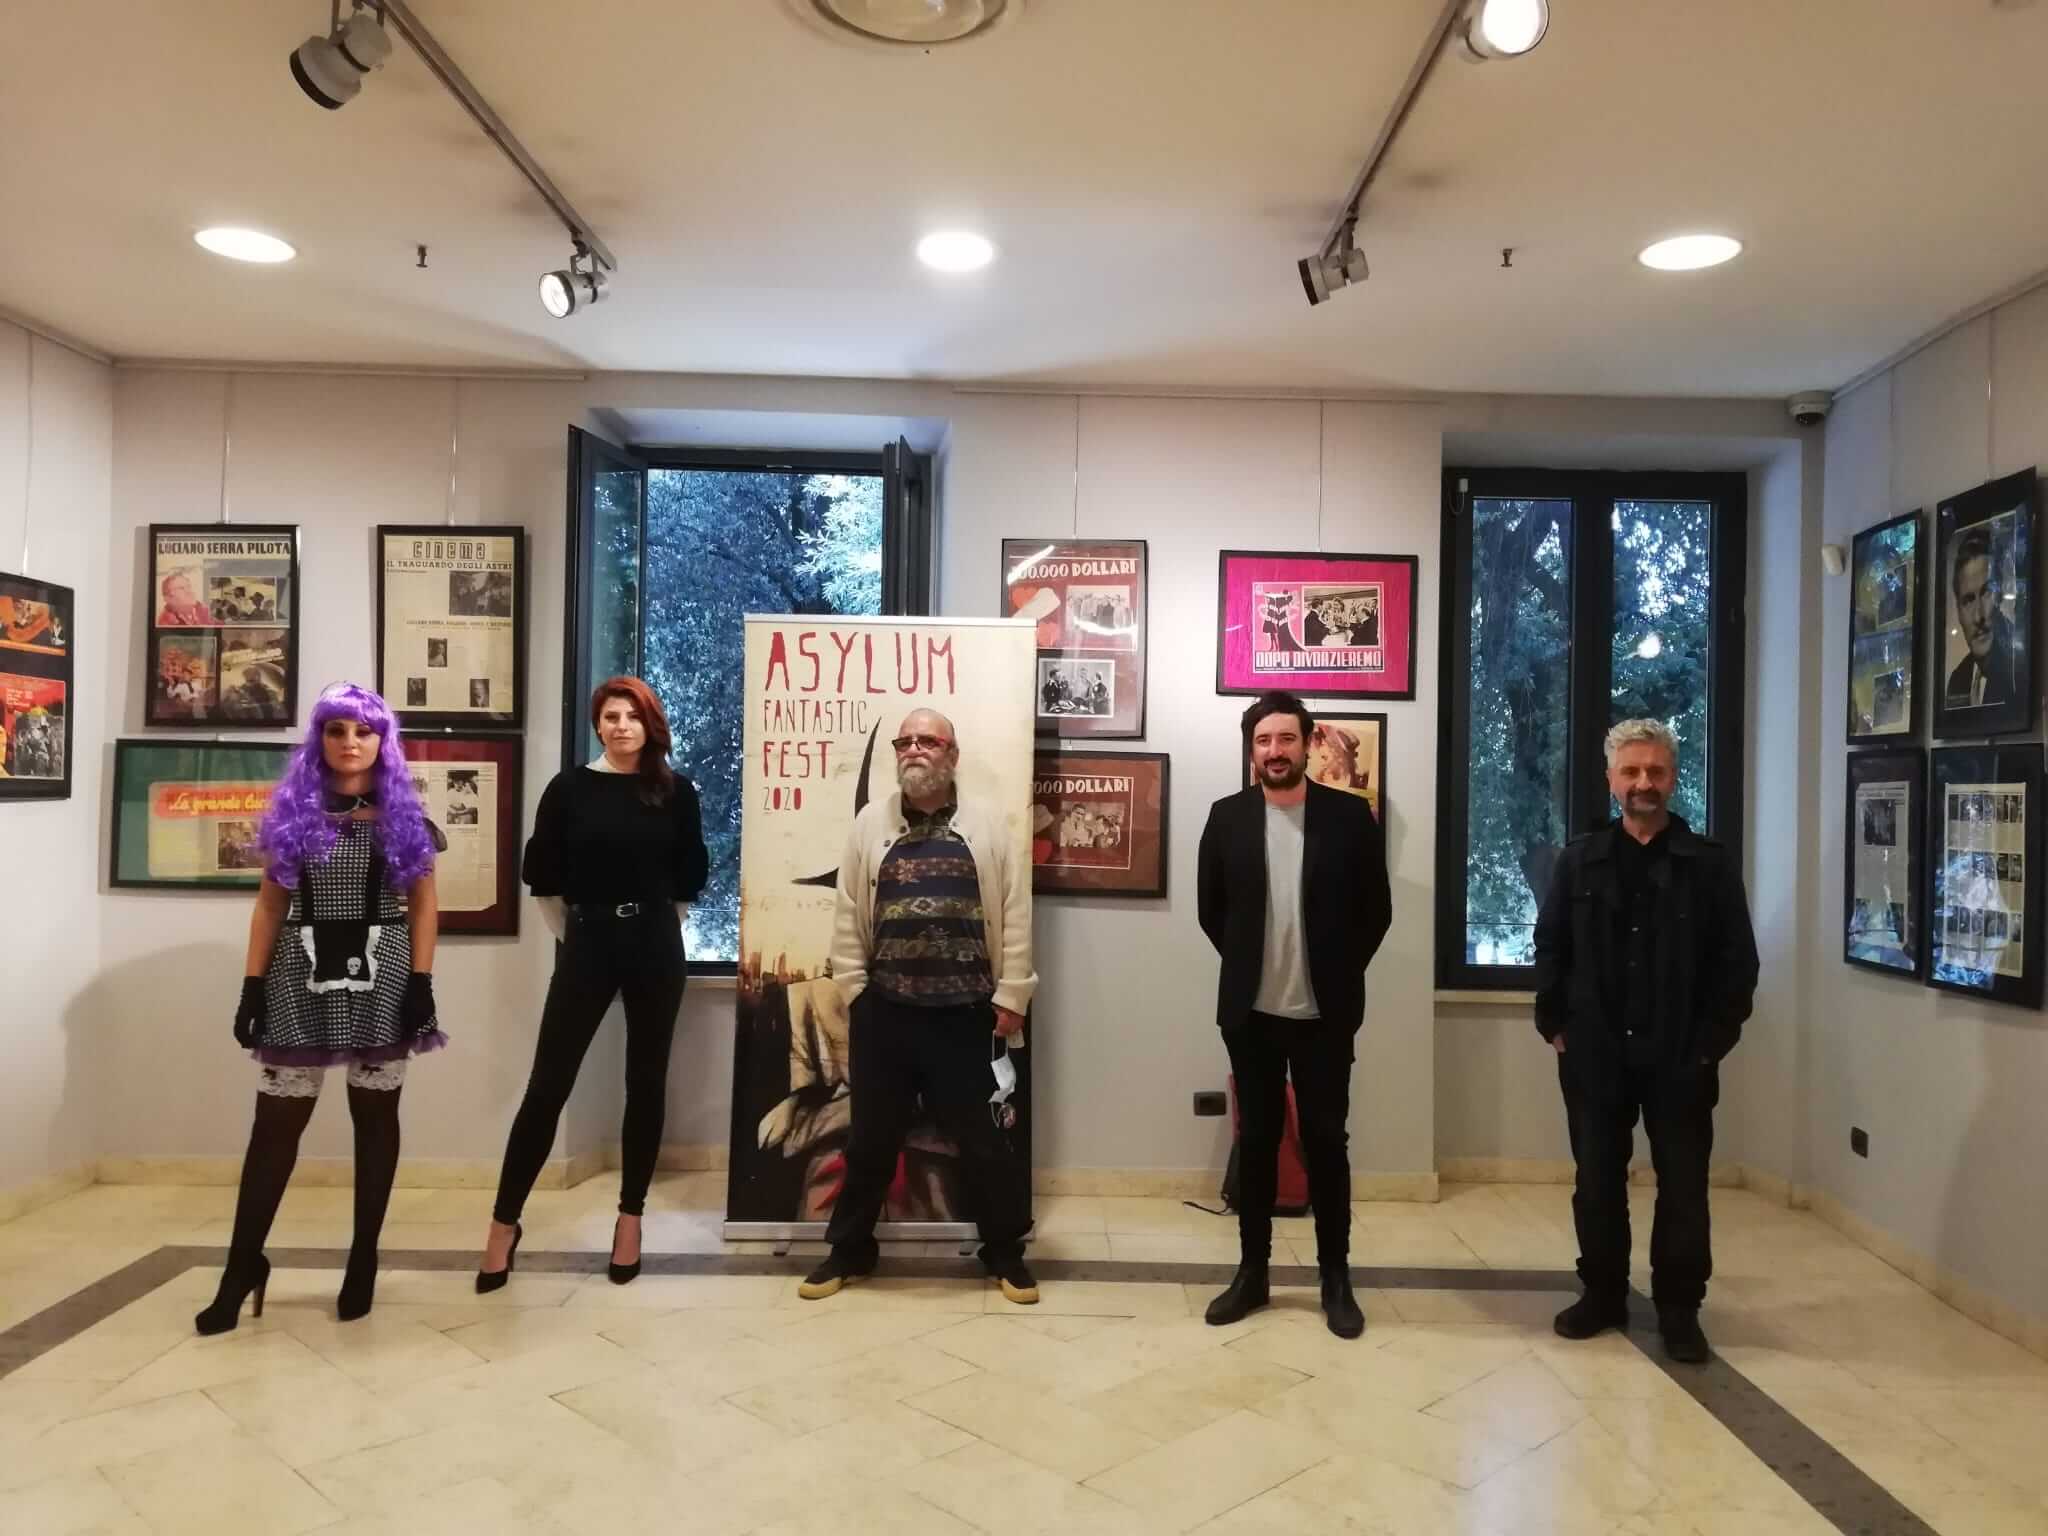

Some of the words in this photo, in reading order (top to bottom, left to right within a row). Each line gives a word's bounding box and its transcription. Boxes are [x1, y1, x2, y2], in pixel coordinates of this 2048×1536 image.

[159, 542, 204, 554] LUCIANO
[207, 542, 243, 554] SERRA
[247, 542, 290, 554] PILOTA
[386, 560, 395, 568] IL
[398, 560, 453, 569] TRAGUARDO
[456, 561, 482, 569] DEGLI
[486, 561, 512, 570] ASTRI
[1071, 560, 1136, 576] DOLLARI
[764, 631, 955, 695] ASYLUM
[1255, 651, 1290, 667] DOPO
[1292, 651, 1382, 668] DIVORZIEREMO
[764, 700, 868, 734] FANTASTIC
[763, 740, 834, 779] FEST
[1065, 778, 1130, 794] DOLLARI
[763, 786, 802, 811] 2020
